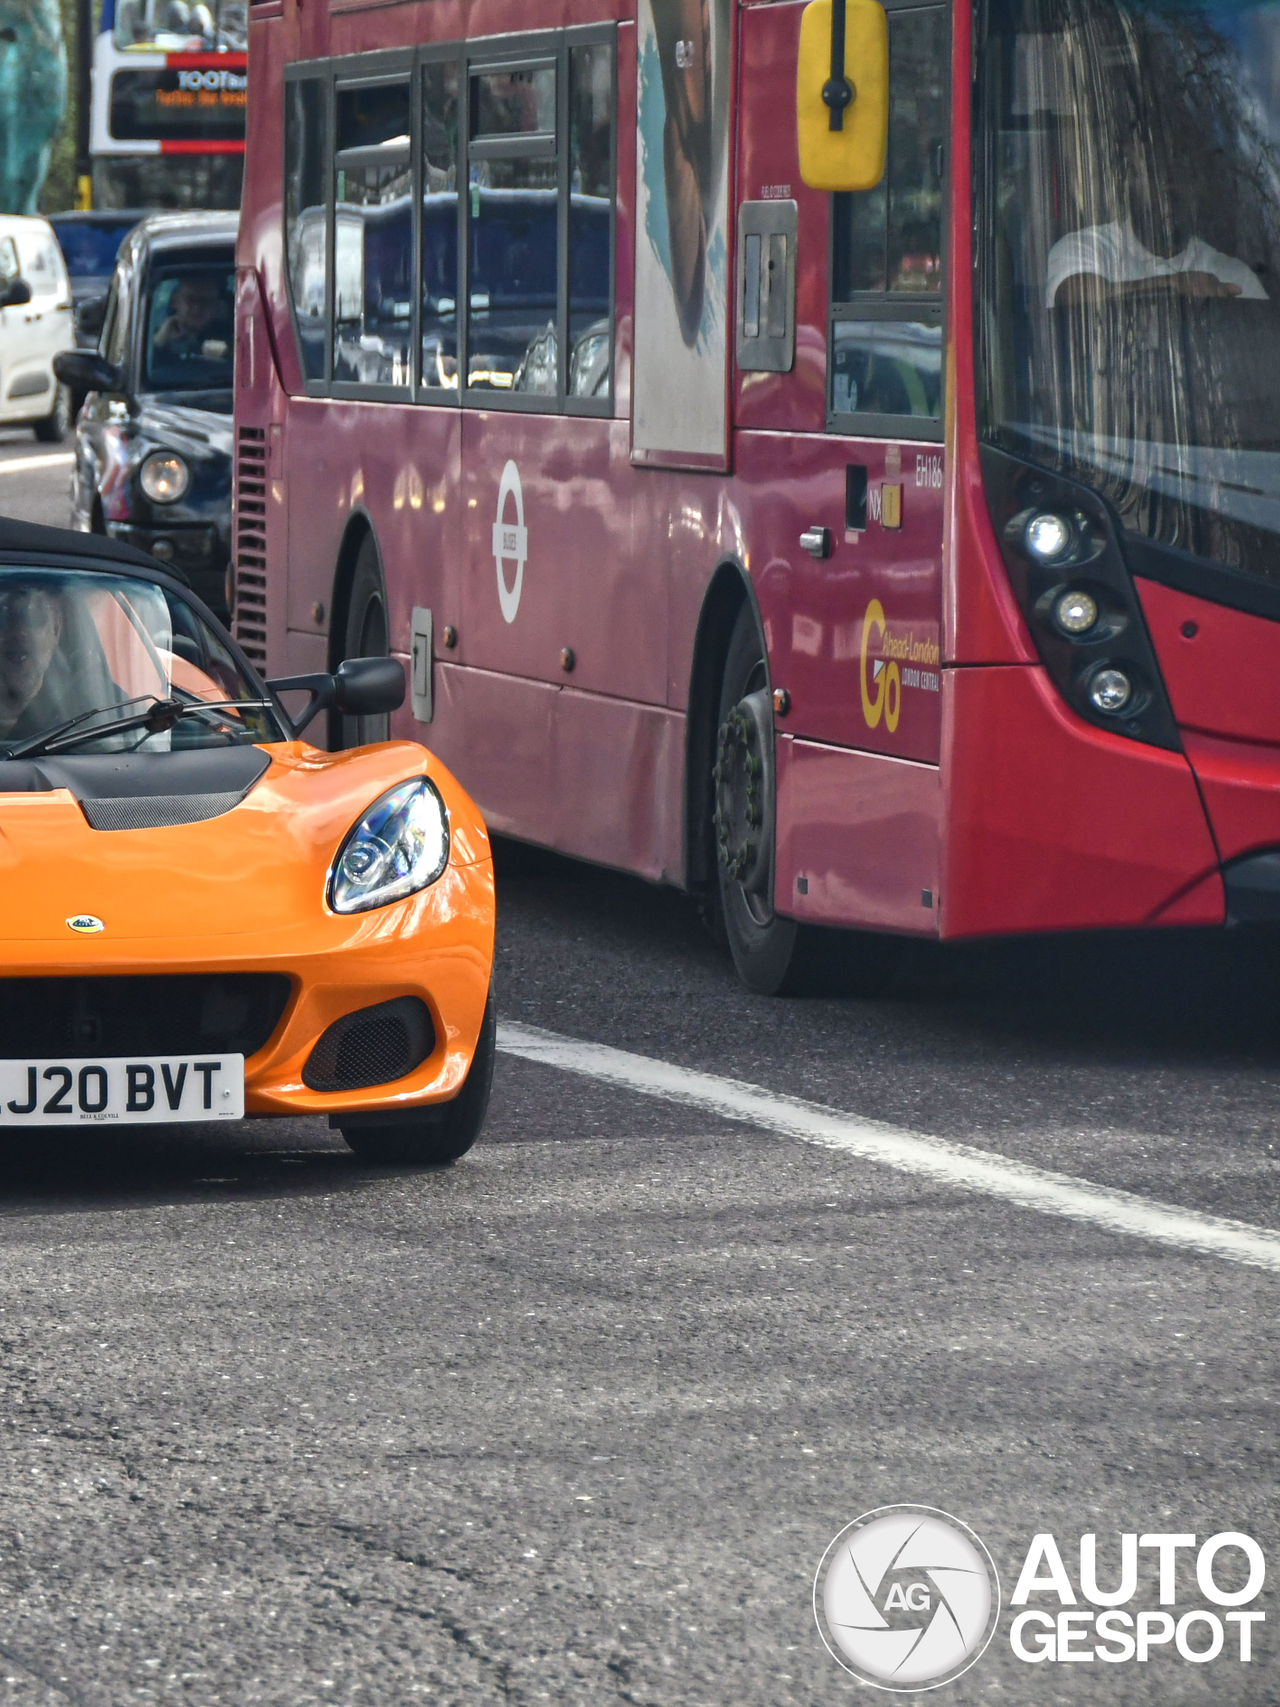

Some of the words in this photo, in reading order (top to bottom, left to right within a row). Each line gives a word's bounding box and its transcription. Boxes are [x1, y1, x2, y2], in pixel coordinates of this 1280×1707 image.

[915, 454, 943, 488] EH186
[860, 598, 901, 733] Go
[901, 667, 920, 689] LONDON
[921, 671, 940, 692] CENTRAL
[125, 1062, 222, 1112] BVT
